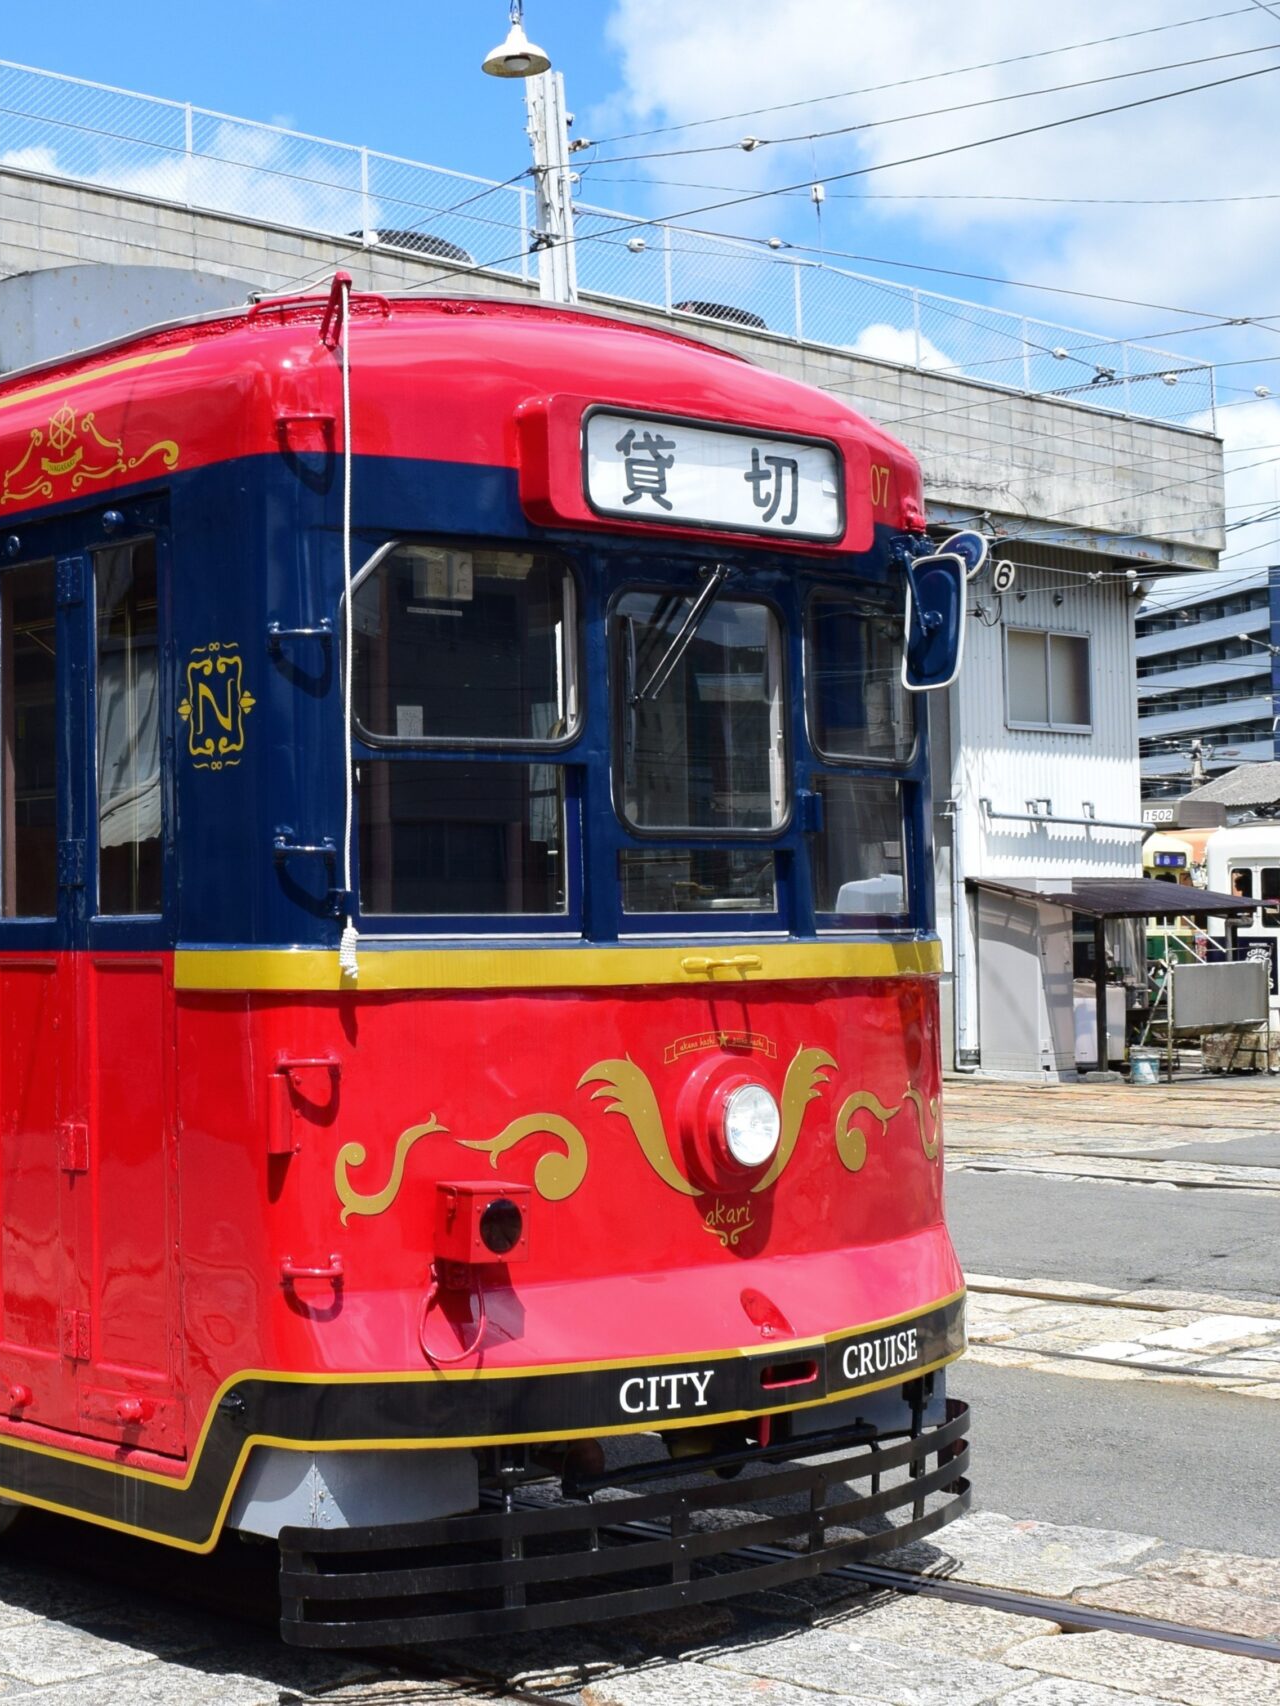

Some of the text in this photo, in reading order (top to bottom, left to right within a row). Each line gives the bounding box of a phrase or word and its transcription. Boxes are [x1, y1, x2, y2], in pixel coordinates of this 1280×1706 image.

[615, 429, 799, 525] 貸切
[997, 563, 1012, 589] 6
[196, 678, 235, 735] N
[1145, 810, 1173, 821] 1502
[706, 1198, 751, 1226] akari
[619, 1328, 918, 1413] CITY CRUISE
